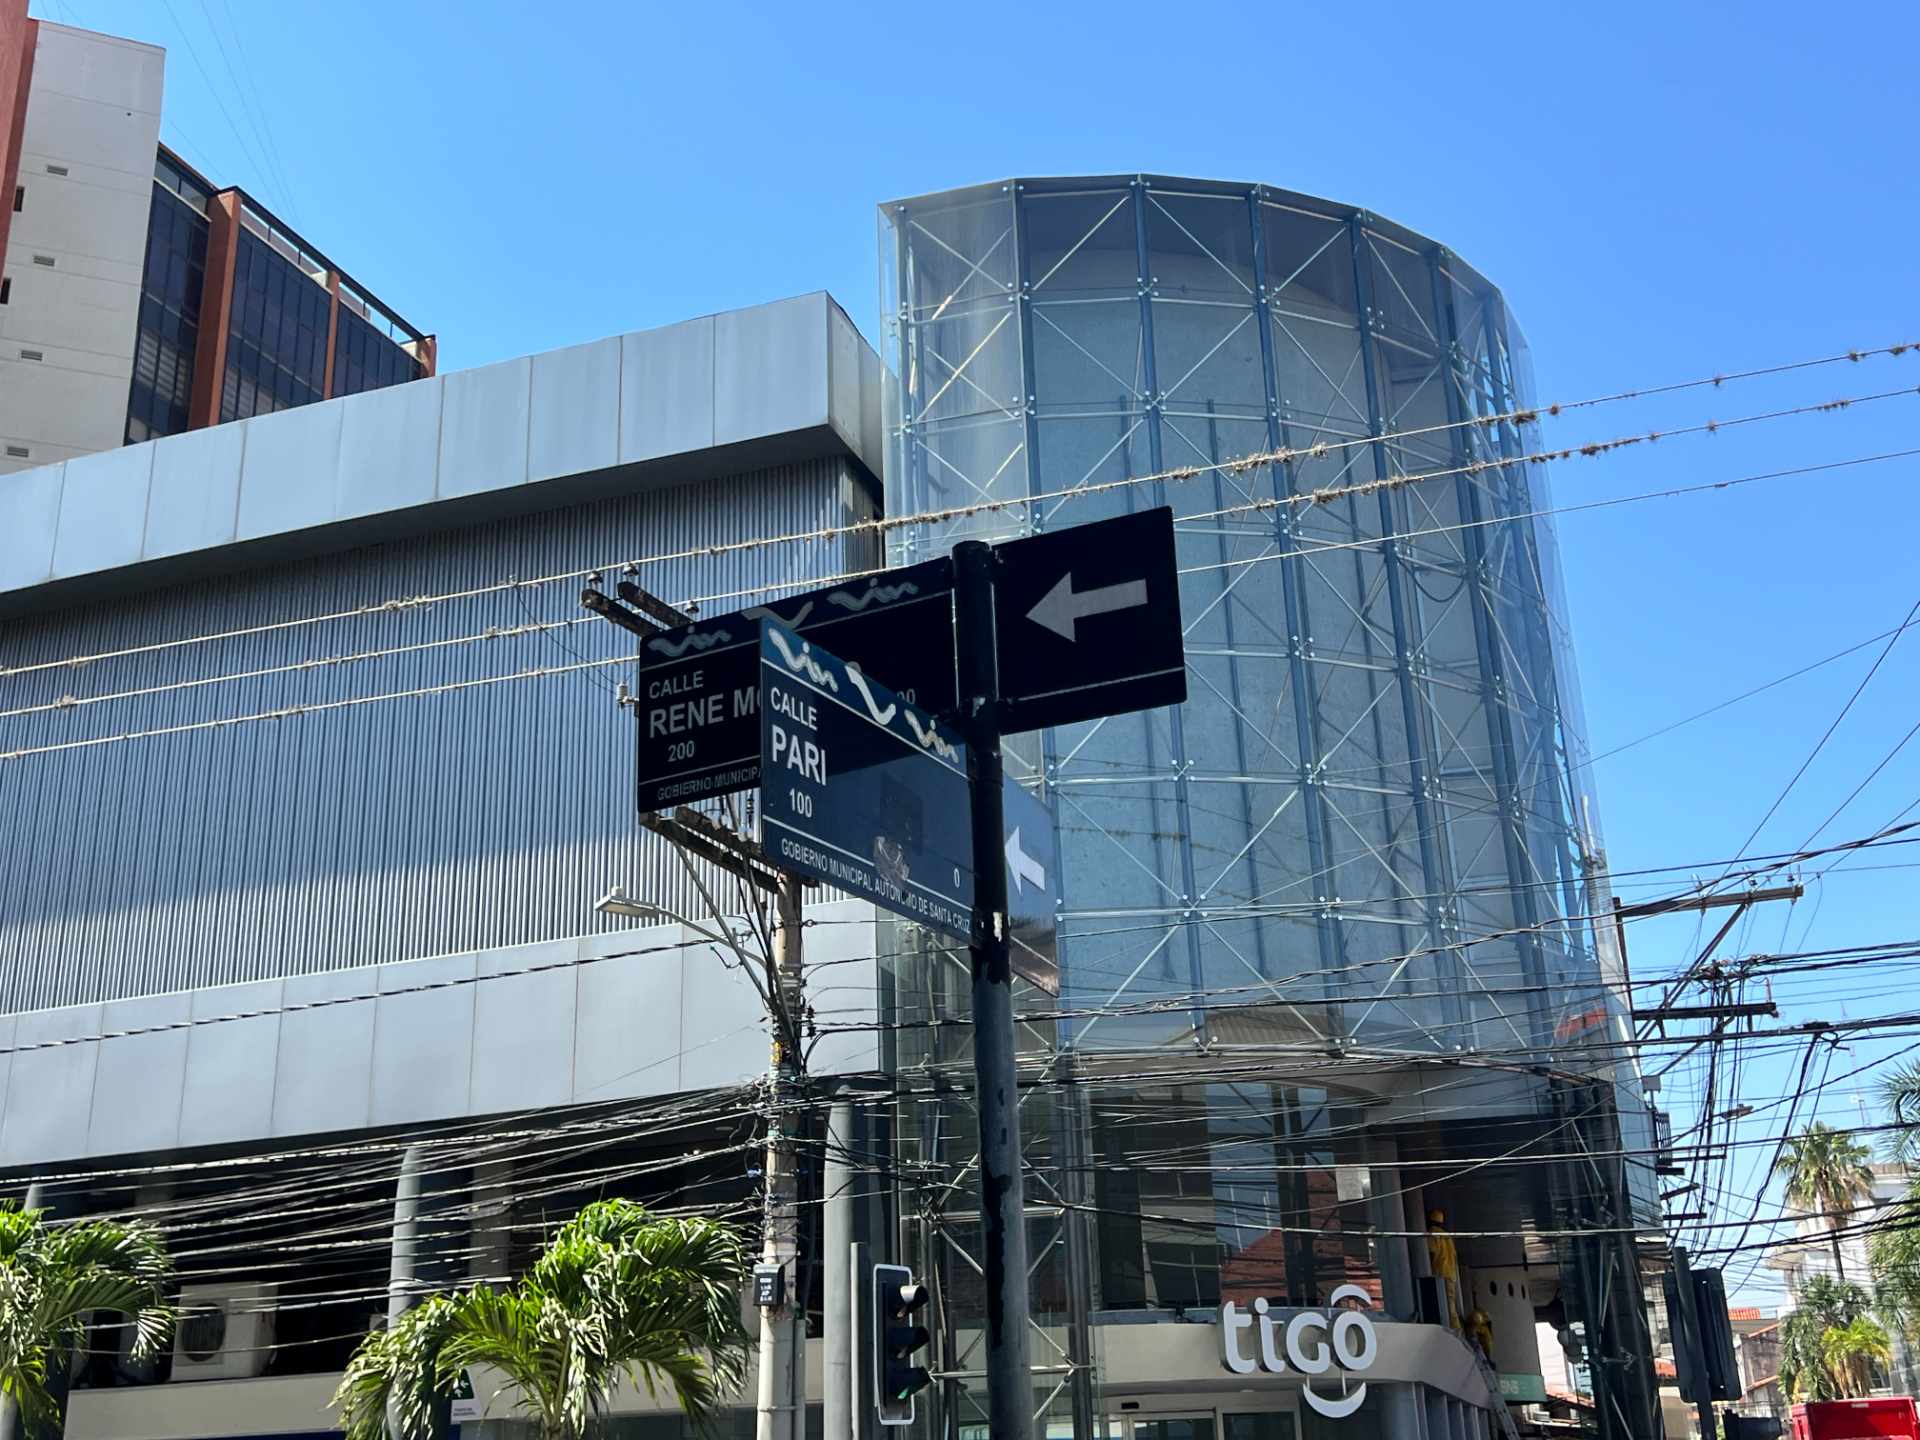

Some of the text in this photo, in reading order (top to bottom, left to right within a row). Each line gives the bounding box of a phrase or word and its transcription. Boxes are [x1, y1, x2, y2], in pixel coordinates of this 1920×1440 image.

[648, 670, 704, 699] CALLE
[649, 684, 761, 739] RENE M
[770, 686, 818, 731] CALLE
[667, 740, 696, 763] 200
[772, 724, 827, 786] PARI
[657, 763, 761, 801] GOBIERNO MUNICIP
[789, 787, 813, 818] 100
[781, 838, 828, 872] GOBIERNO
[829, 857, 873, 892] MUNICIPAL
[918, 896, 929, 916] DE
[929, 902, 952, 927] SANTA
[952, 911, 971, 934] CRUZ
